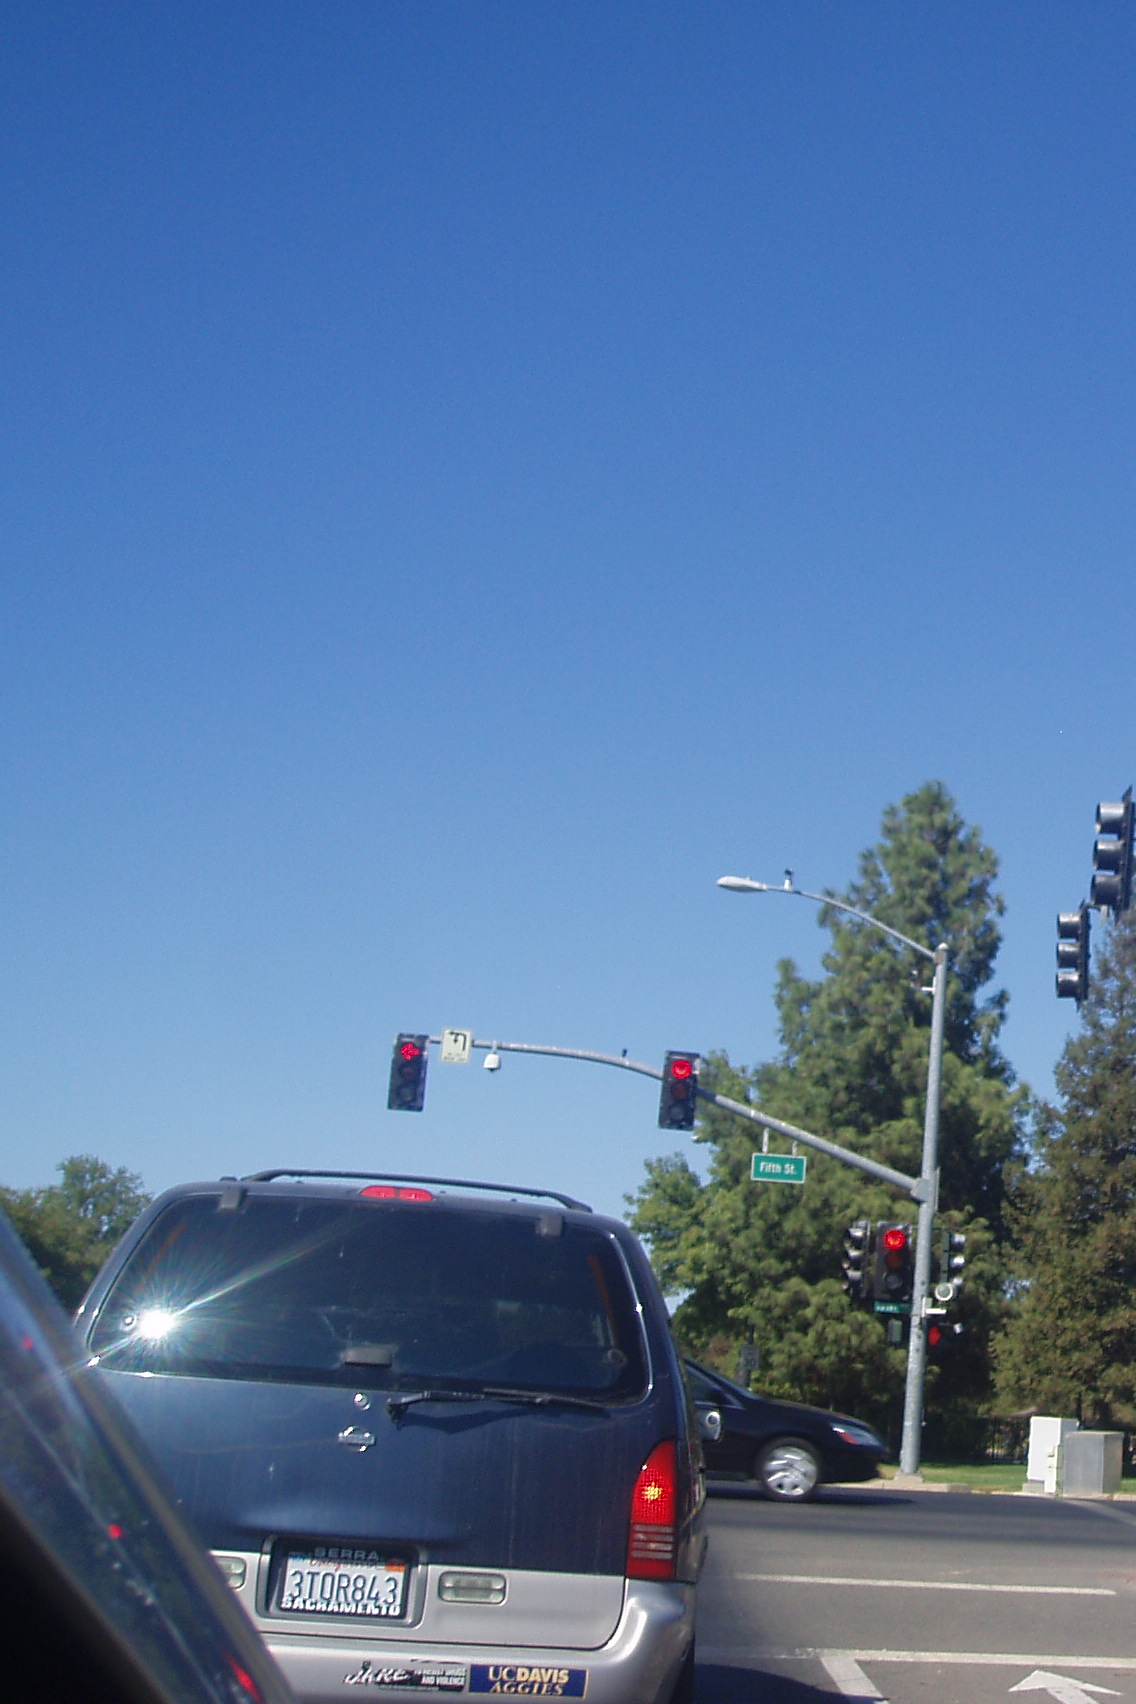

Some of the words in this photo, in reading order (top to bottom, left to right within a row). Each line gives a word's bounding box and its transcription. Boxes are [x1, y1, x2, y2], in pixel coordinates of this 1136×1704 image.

[760, 1161, 782, 1174] Fifth
[288, 1568, 399, 1605] 3TOR843
[280, 1594, 402, 1617] SACRAMENTO
[488, 1680, 564, 1695] AGGIES
